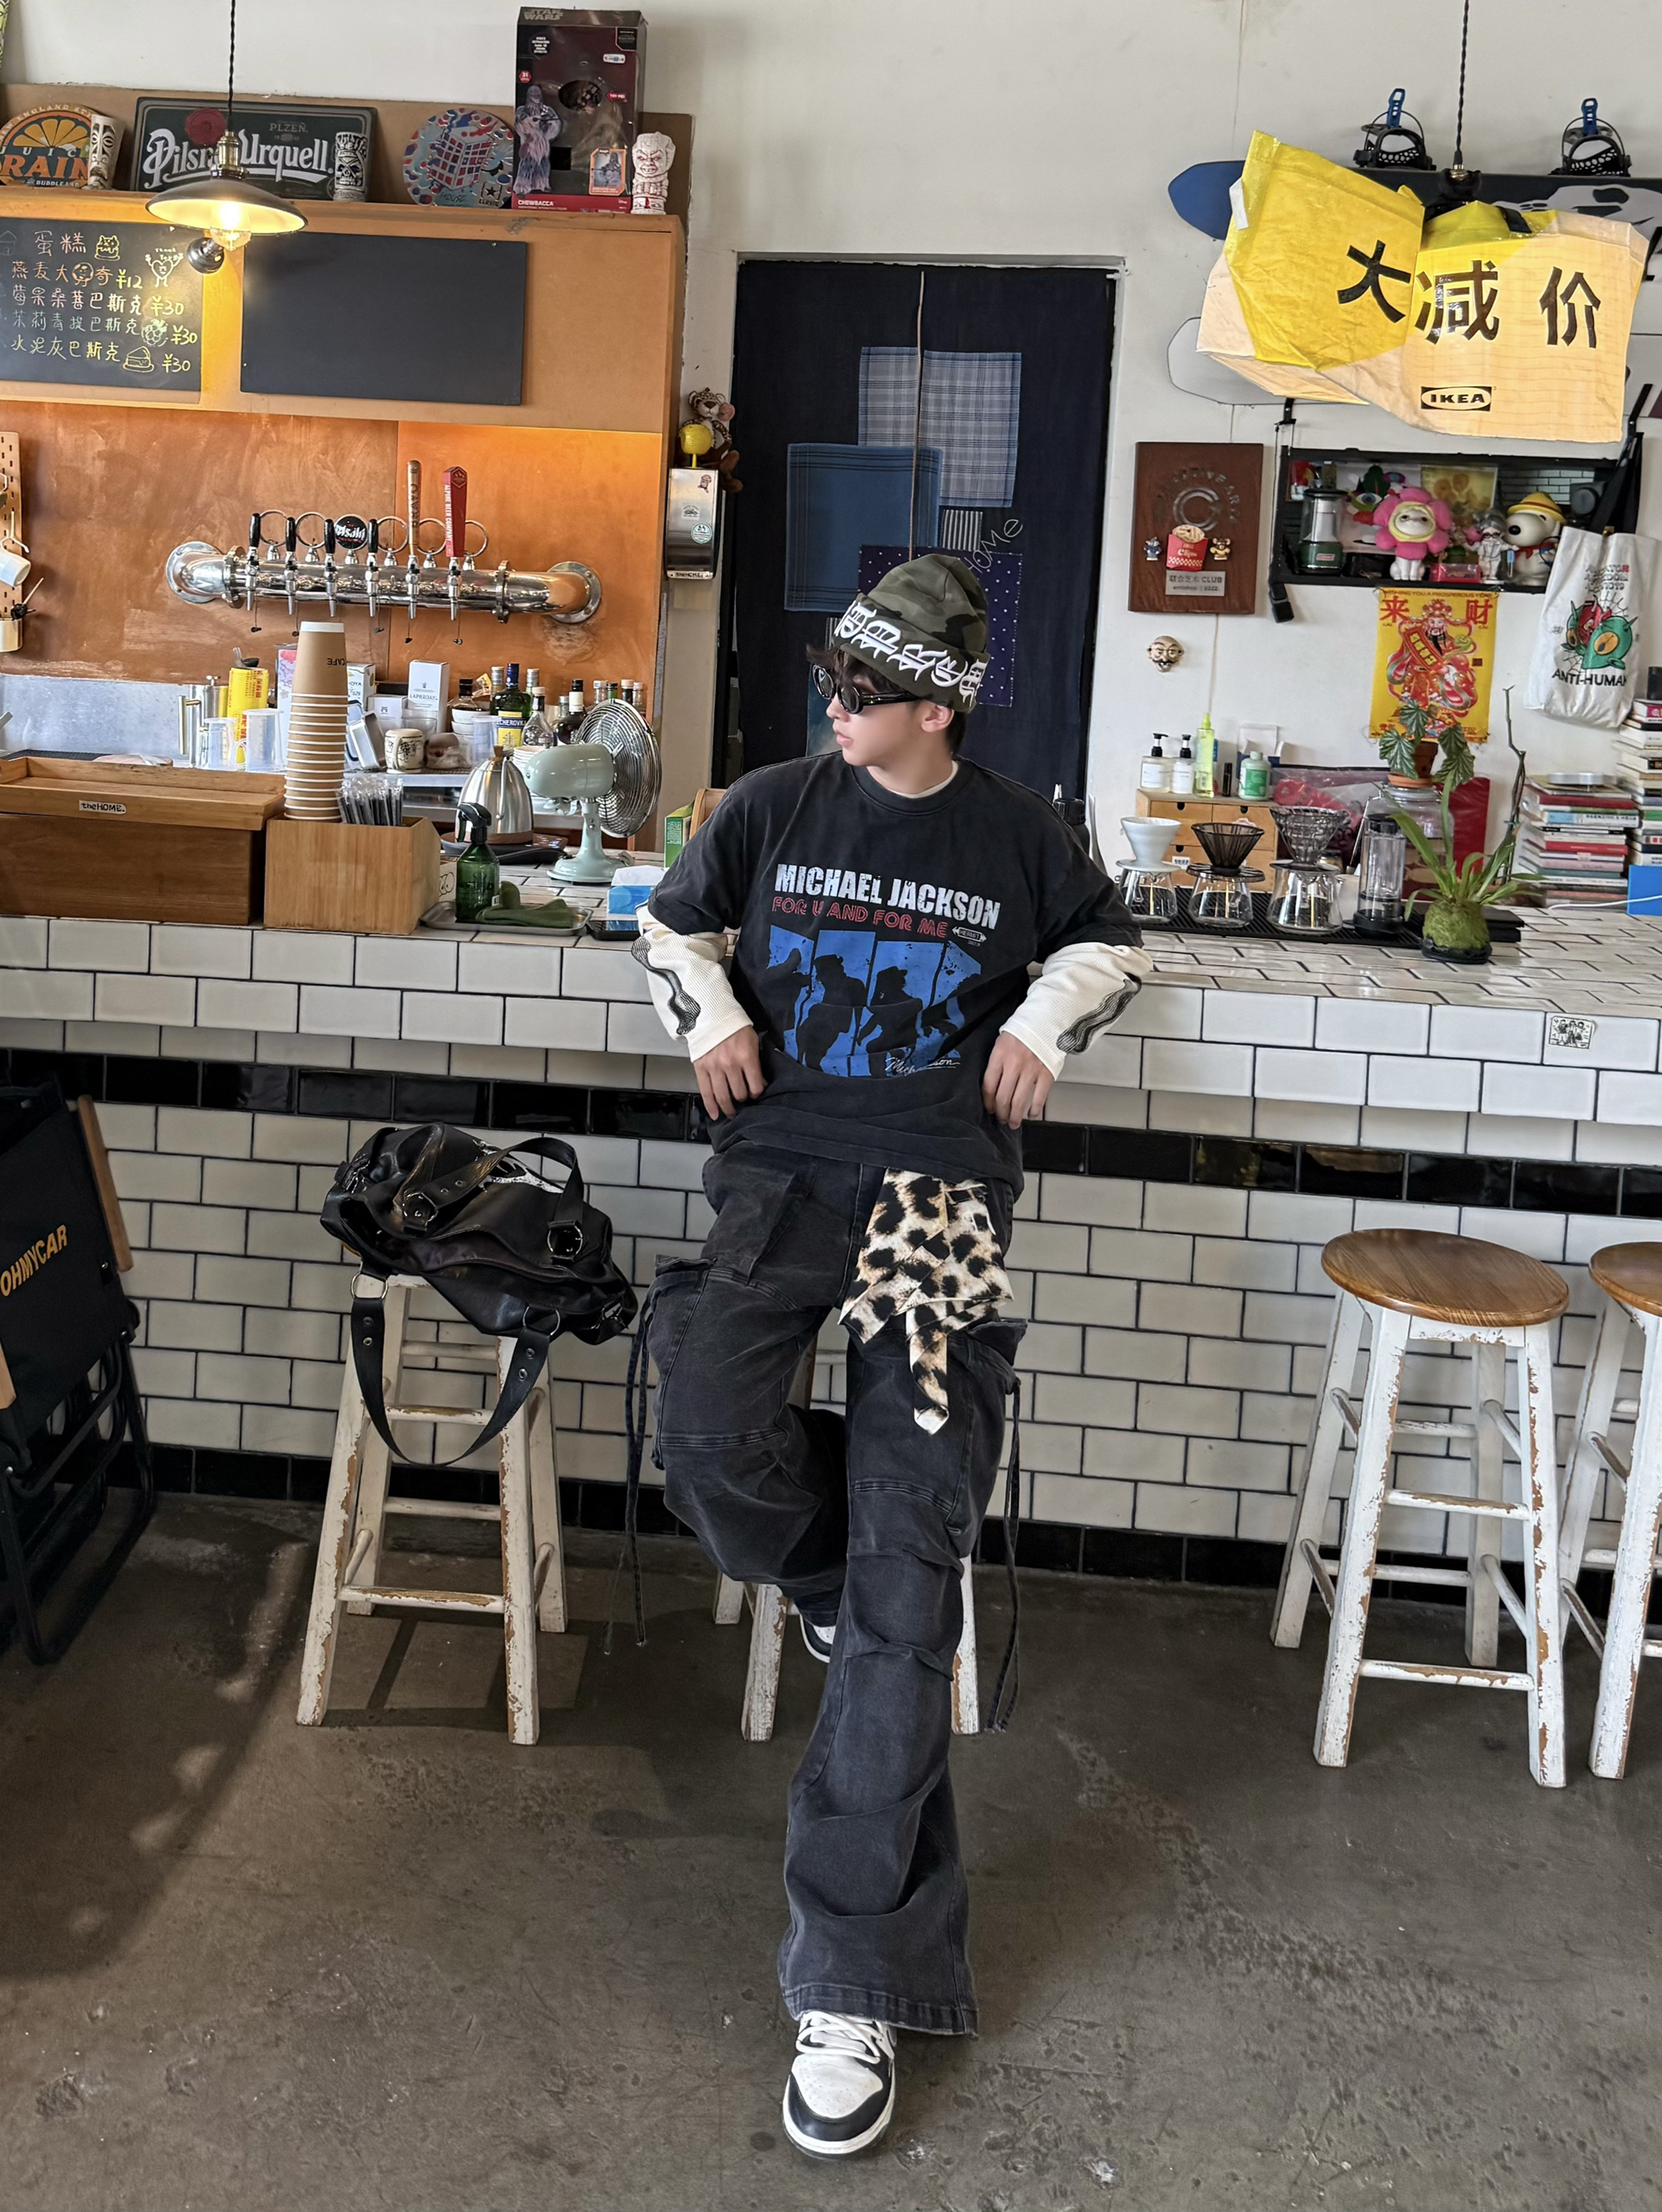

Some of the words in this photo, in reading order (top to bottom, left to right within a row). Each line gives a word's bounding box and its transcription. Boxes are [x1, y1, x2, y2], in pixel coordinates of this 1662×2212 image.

[35, 231, 86, 257] 蛋糕
[115, 268, 143, 289] ¥12
[1337, 239, 1601, 349] 大减价
[150, 295, 184, 316] ¥30
[170, 324, 198, 345] ¥30
[162, 353, 191, 373] ¥30
[1430, 394, 1486, 404] IKEA
[335, 524, 366, 541] Asahi
[1201, 576, 1223, 584] CLUB
[1380, 595, 1412, 623] 来
[1465, 599, 1493, 625] 财
[81, 802, 126, 813] theHOME.
[774, 863, 883, 905] MICHAEL
[887, 878, 1001, 931] JACKSON
[772, 896, 807, 915] FOR
[811, 899, 824, 917] U
[826, 903, 869, 923] AND
[872, 910, 913, 932] FOR
[917, 917, 949, 939] ME
[0, 1224, 68, 1297] OHMYCAR
